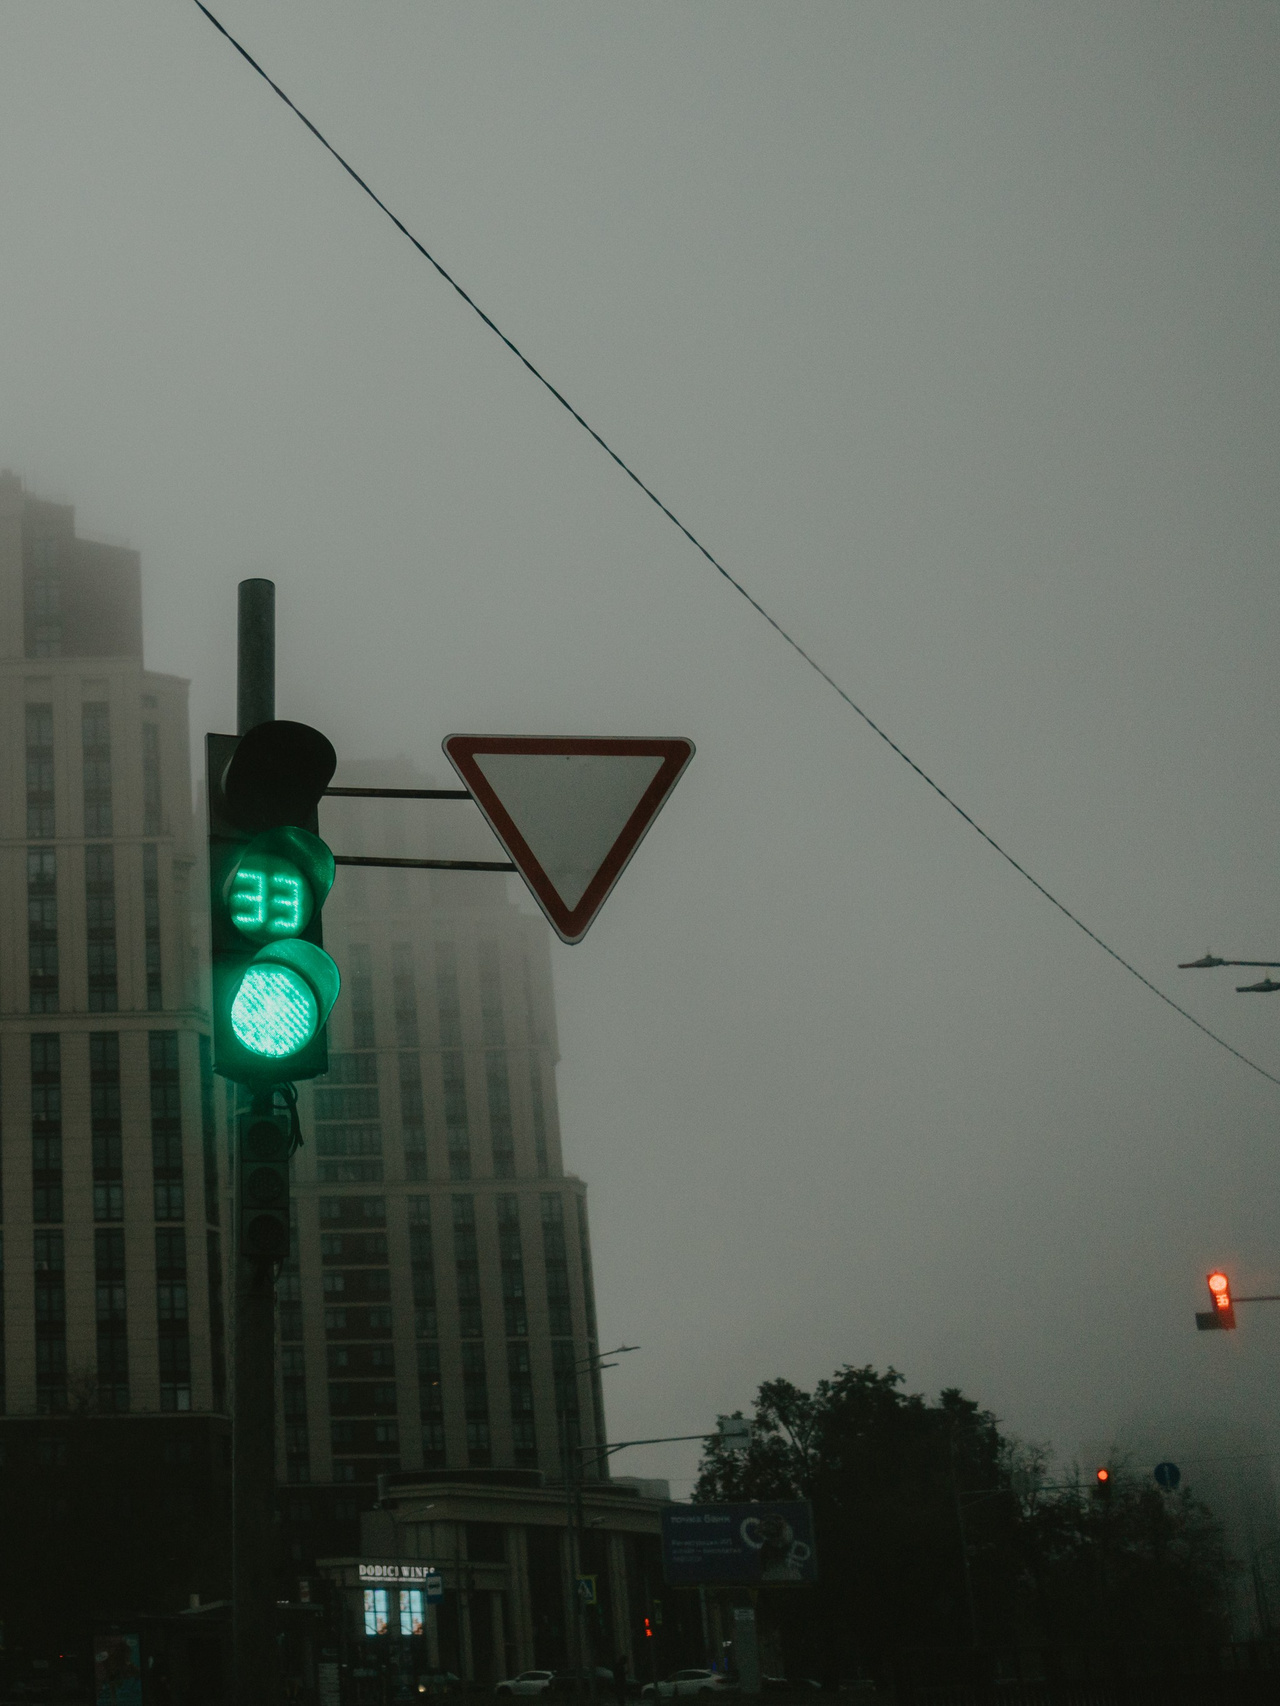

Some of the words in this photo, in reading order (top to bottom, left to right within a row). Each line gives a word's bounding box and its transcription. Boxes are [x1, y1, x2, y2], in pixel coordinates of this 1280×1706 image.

[231, 869, 302, 931] 33
[703, 1514, 731, 1524] банк
[359, 1564, 399, 1577] DODICI
